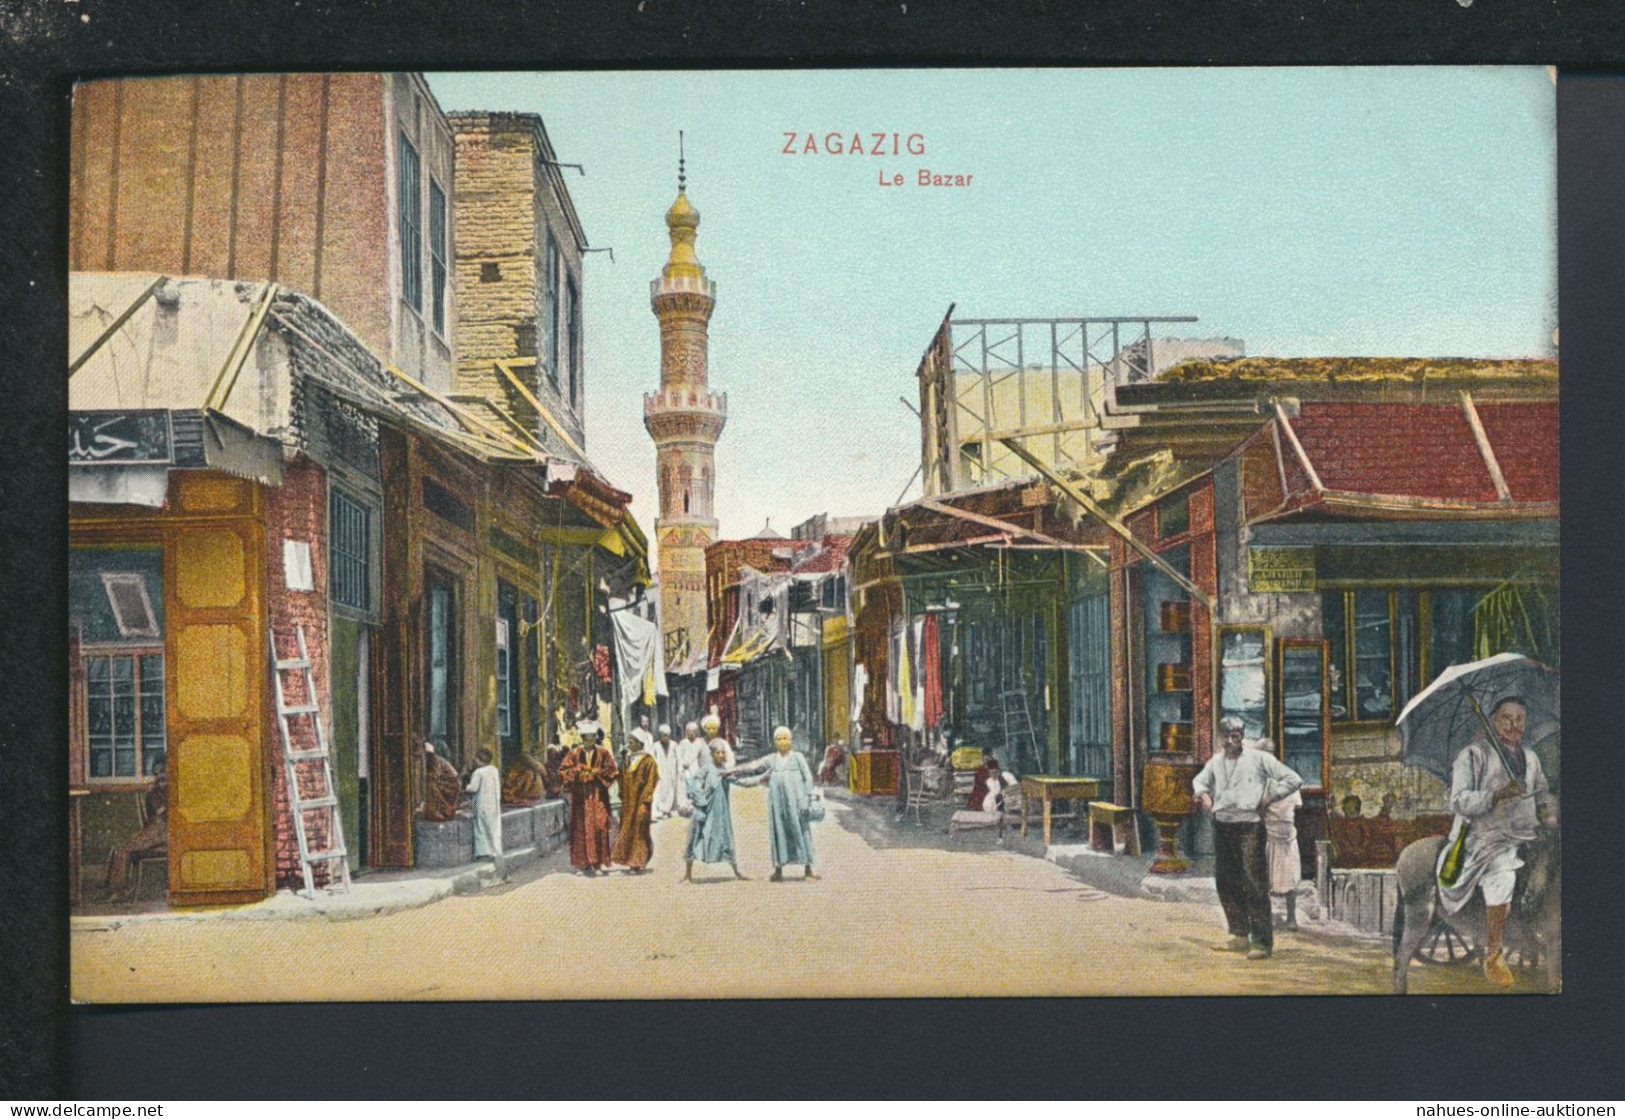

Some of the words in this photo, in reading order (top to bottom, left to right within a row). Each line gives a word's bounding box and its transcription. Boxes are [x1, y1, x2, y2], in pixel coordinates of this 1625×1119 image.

[782, 132, 926, 156] ZAGAZIG
[879, 170, 904, 187] Le
[918, 169, 973, 187] Bazar
